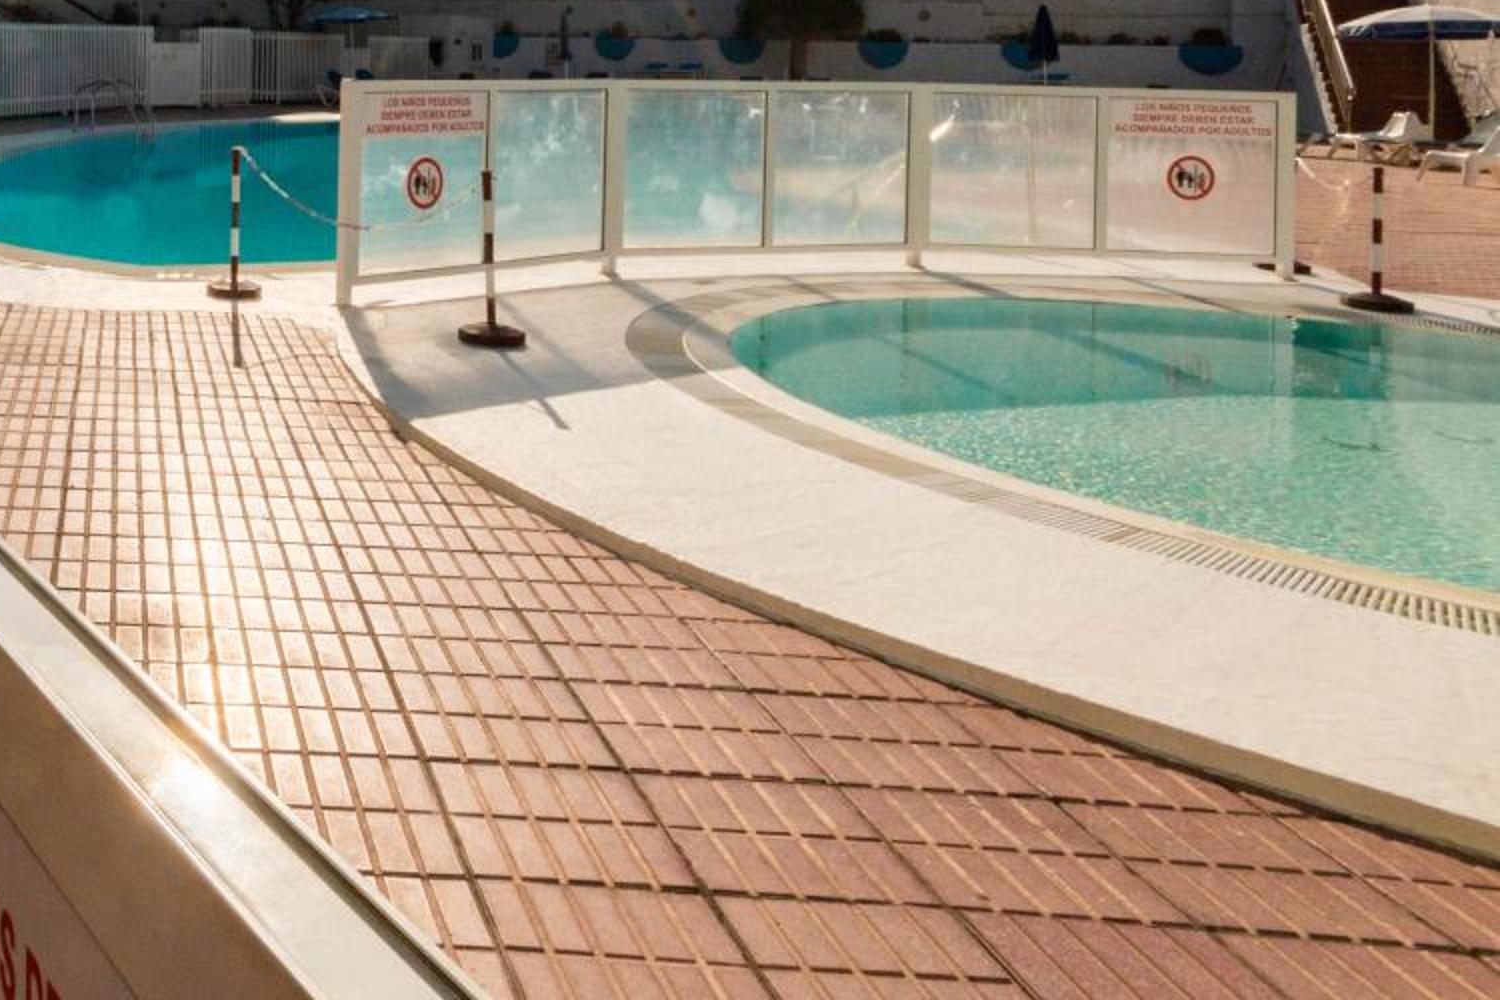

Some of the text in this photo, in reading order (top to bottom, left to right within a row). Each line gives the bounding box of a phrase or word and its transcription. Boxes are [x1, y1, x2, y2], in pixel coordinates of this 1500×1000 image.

[1134, 103, 1156, 112] LOS
[1159, 102, 1190, 112] NIÑOS
[381, 110, 416, 120] SIEMPRE
[1133, 112, 1254, 125] SIEMPRE DEBEN ESTAR
[431, 122, 449, 132] POR
[1198, 124, 1222, 135] POR
[1224, 125, 1272, 137] ADULTOS
